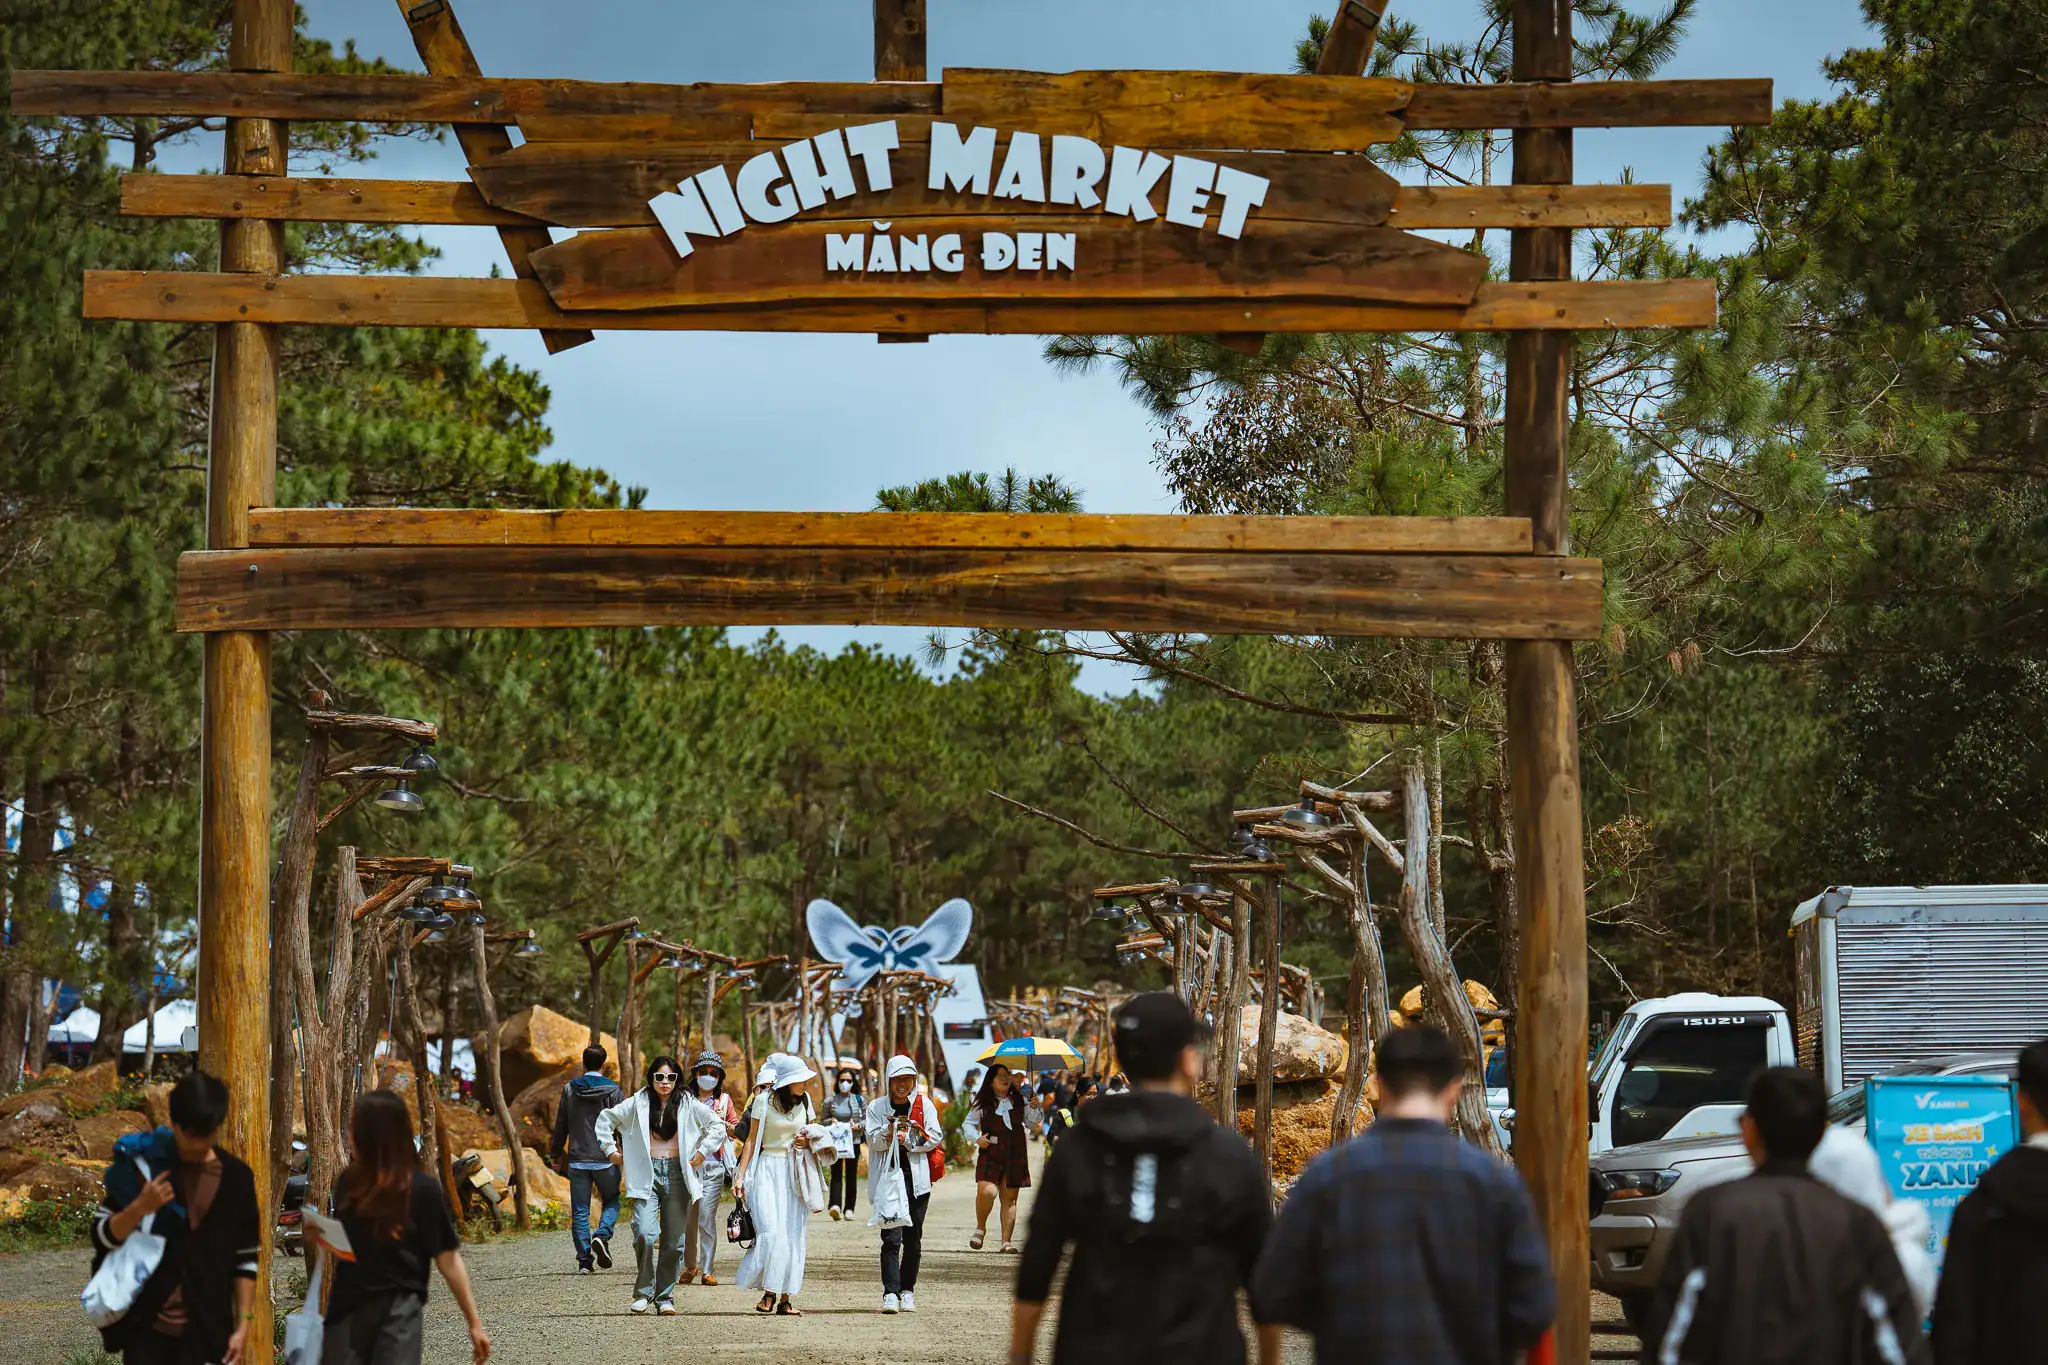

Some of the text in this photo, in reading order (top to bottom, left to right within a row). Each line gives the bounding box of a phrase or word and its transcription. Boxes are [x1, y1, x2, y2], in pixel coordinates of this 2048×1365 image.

[648, 120, 1270, 258] NIGHT MARKET
[825, 221, 1076, 272] MĂNG ĐEN
[1683, 1016, 1745, 1026] ISUZU
[1902, 1124, 1931, 1145] XE
[1901, 1161, 1990, 1190] XANH
